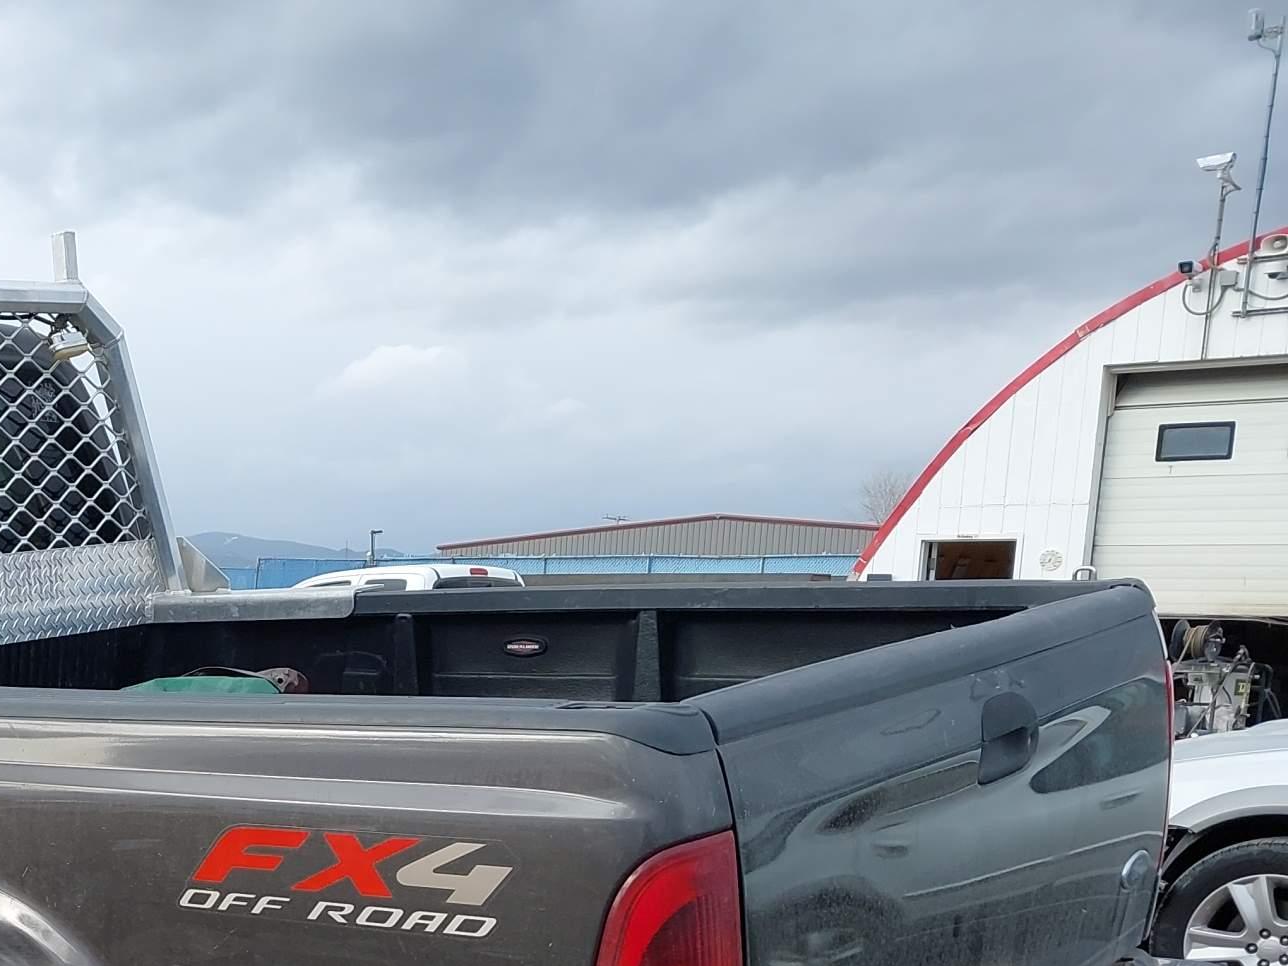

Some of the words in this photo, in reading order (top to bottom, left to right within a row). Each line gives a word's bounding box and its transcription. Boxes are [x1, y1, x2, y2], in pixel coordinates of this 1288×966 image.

[190, 827, 513, 906] FX4
[179, 888, 291, 914] OFF
[307, 901, 498, 938] ROAD
